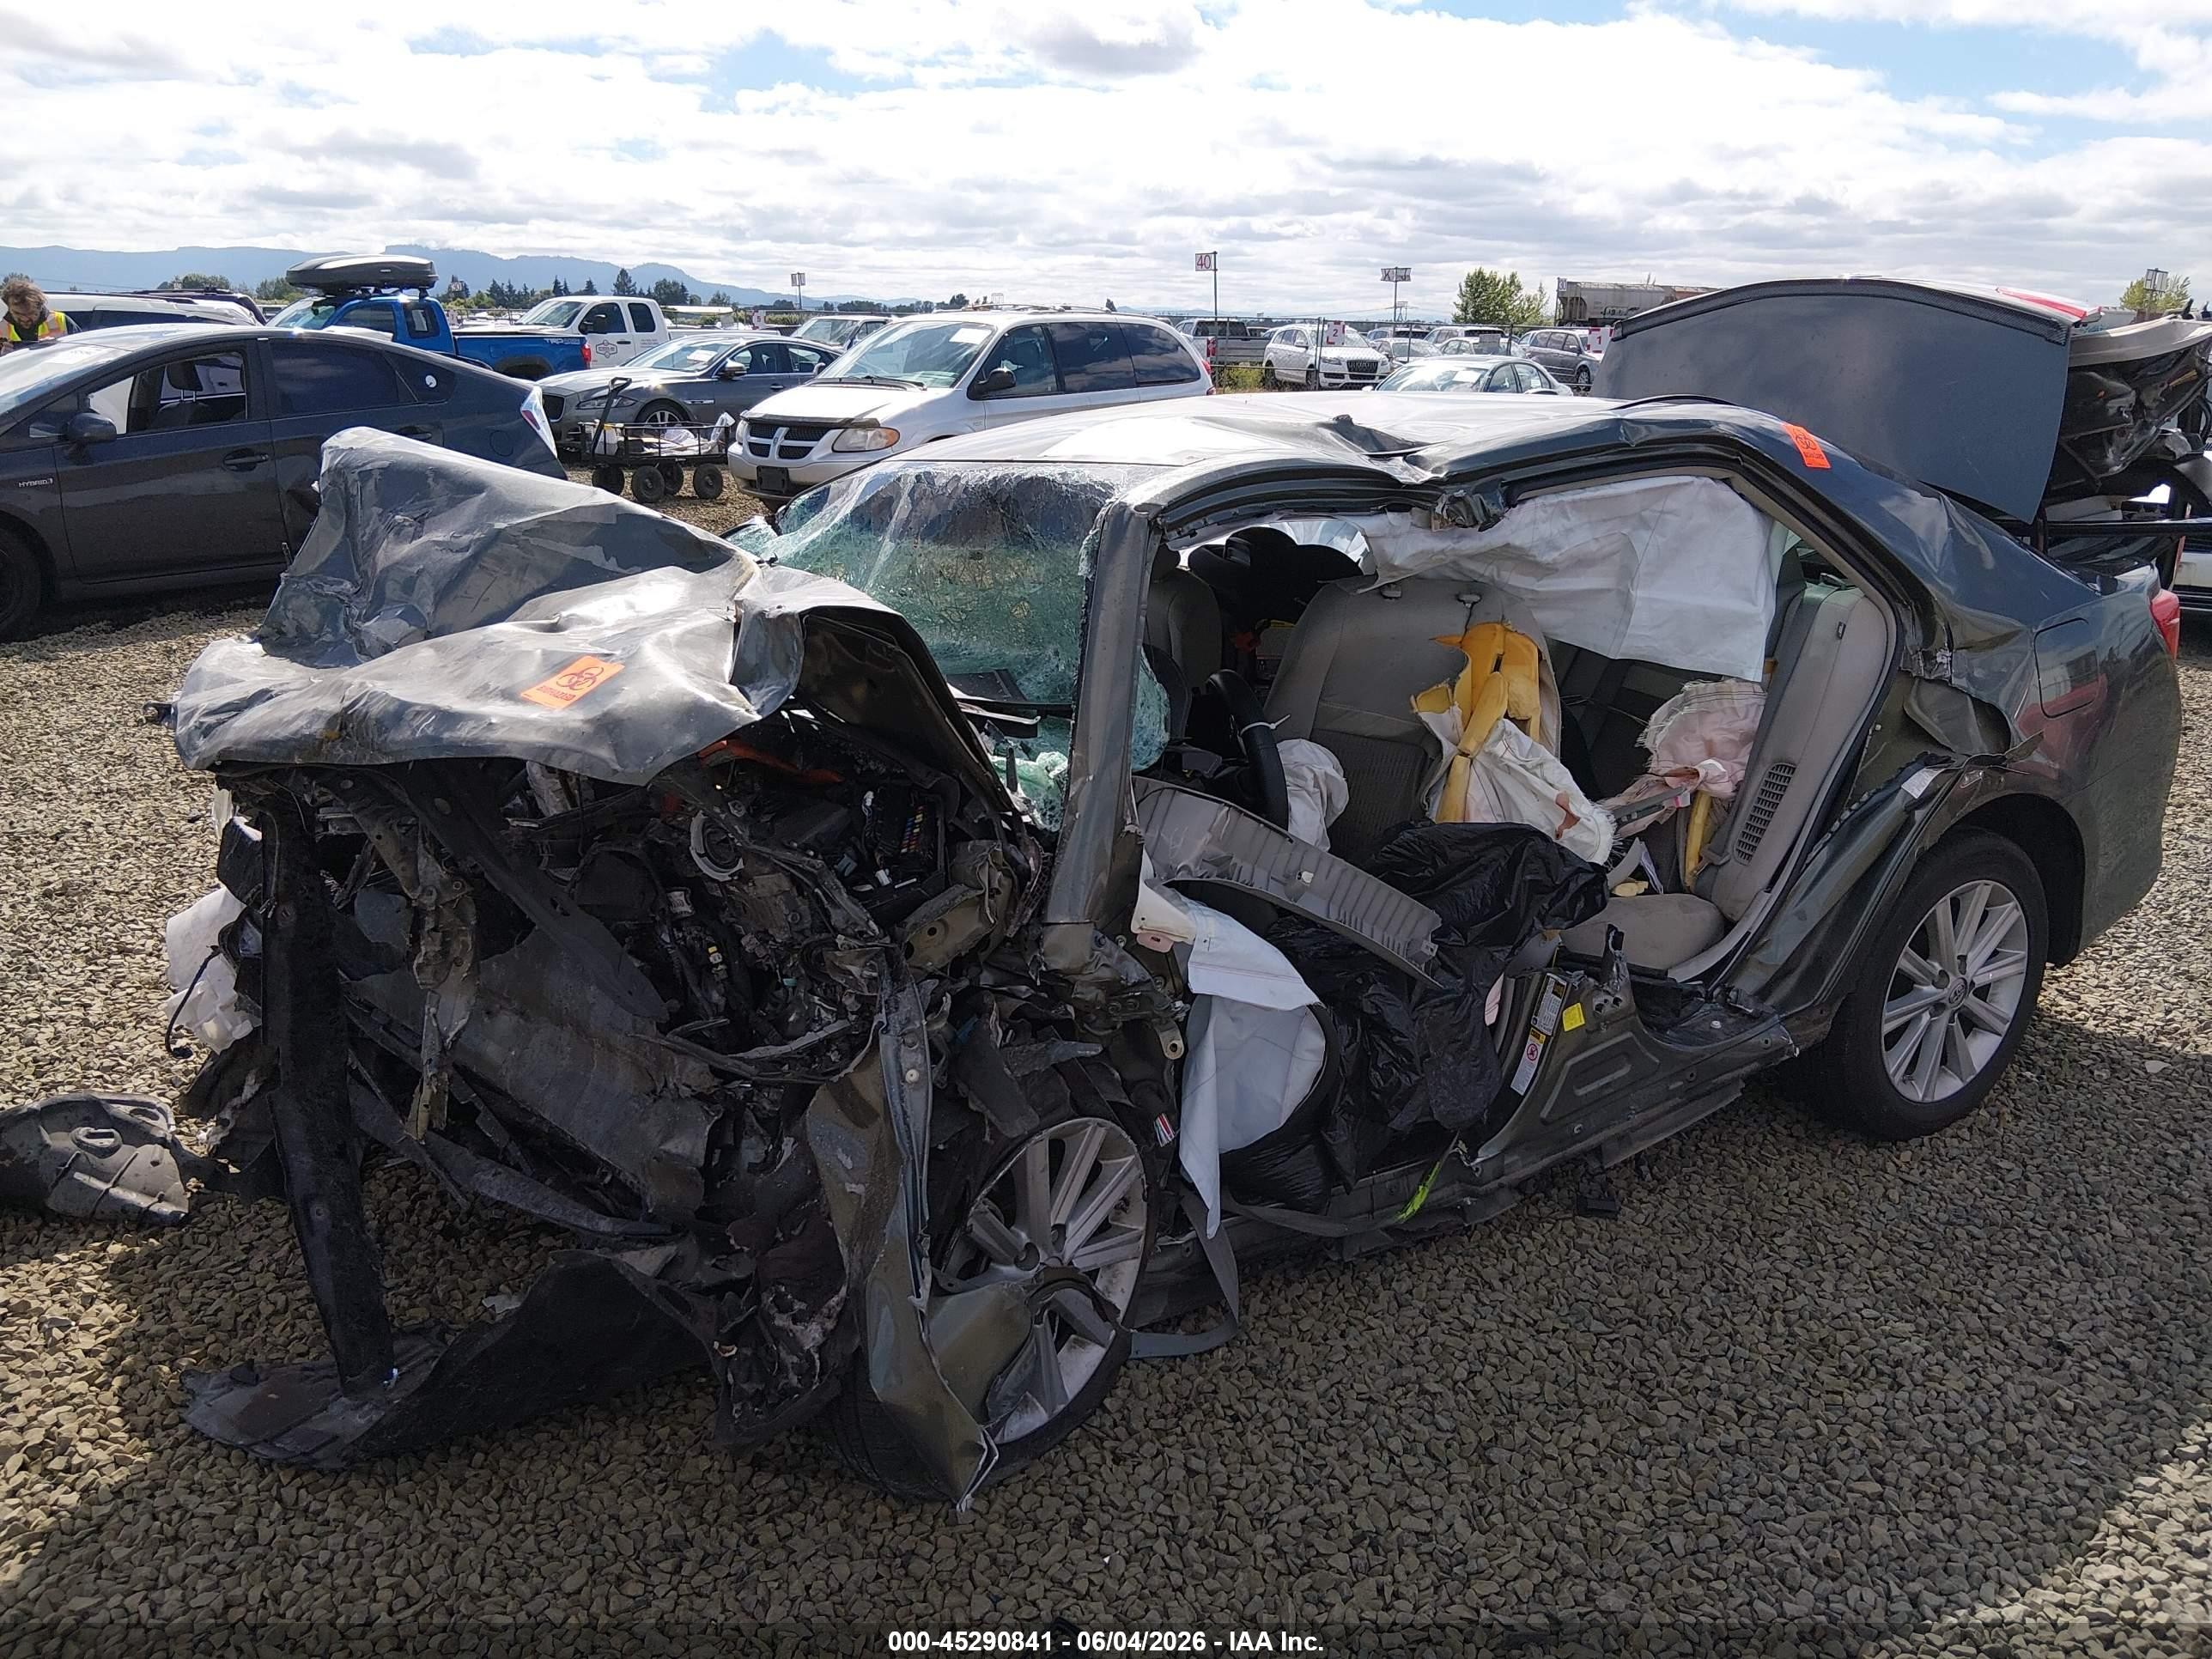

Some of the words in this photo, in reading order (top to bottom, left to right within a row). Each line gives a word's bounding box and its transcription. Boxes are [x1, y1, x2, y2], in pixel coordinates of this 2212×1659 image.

[1196, 254, 1211, 270] 40
[1333, 328, 1339, 337] 2
[1596, 336, 1601, 345] 1
[18, 479, 48, 488] HYBRID
